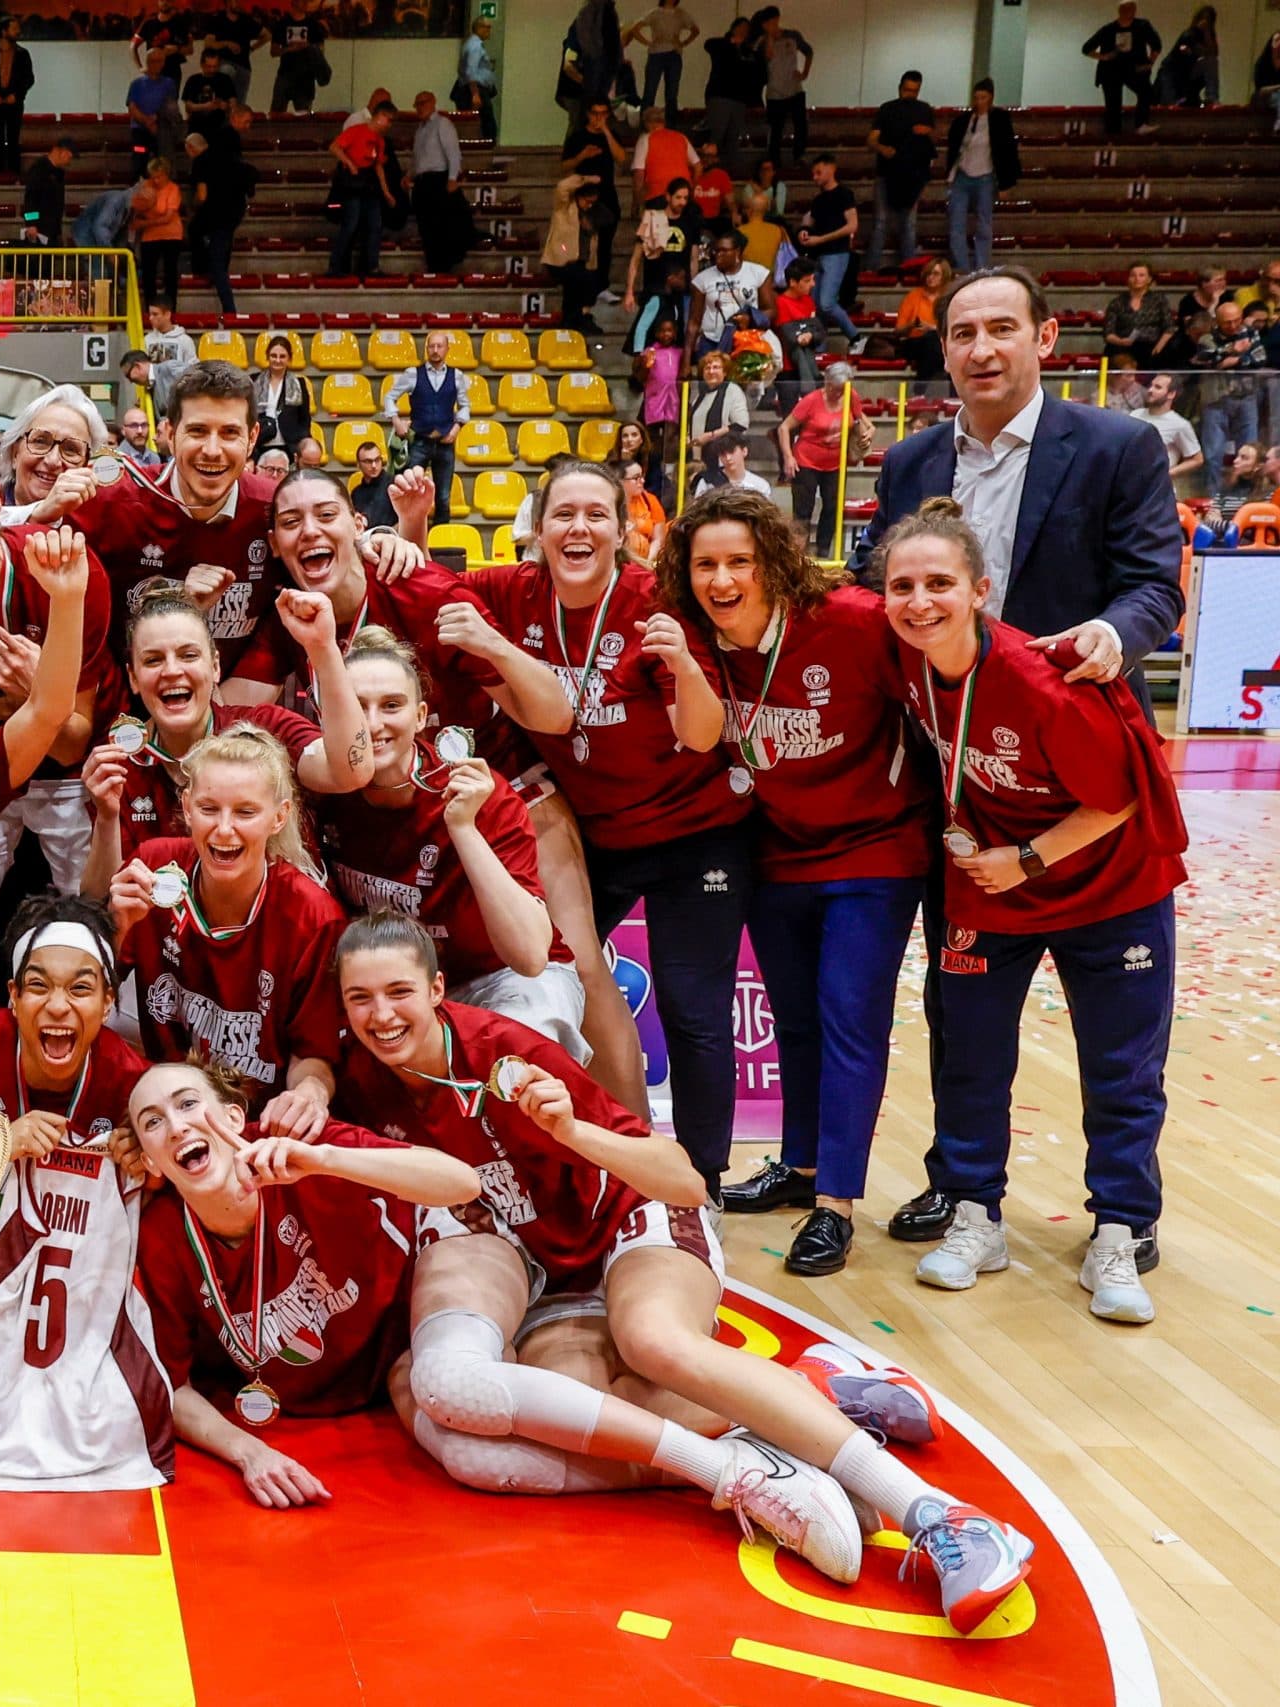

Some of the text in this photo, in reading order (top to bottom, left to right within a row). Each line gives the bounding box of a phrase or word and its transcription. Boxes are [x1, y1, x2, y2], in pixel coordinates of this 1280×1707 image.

[1133, 182, 1144, 199] H
[1169, 216, 1181, 236] H
[527, 292, 540, 313] G
[87, 336, 106, 368] G
[131, 813, 157, 822] errea
[704, 883, 728, 892] errea
[1124, 960, 1153, 971] errea
[40, 1191, 91, 1236] ORINI
[23, 1245, 73, 1370] 5
